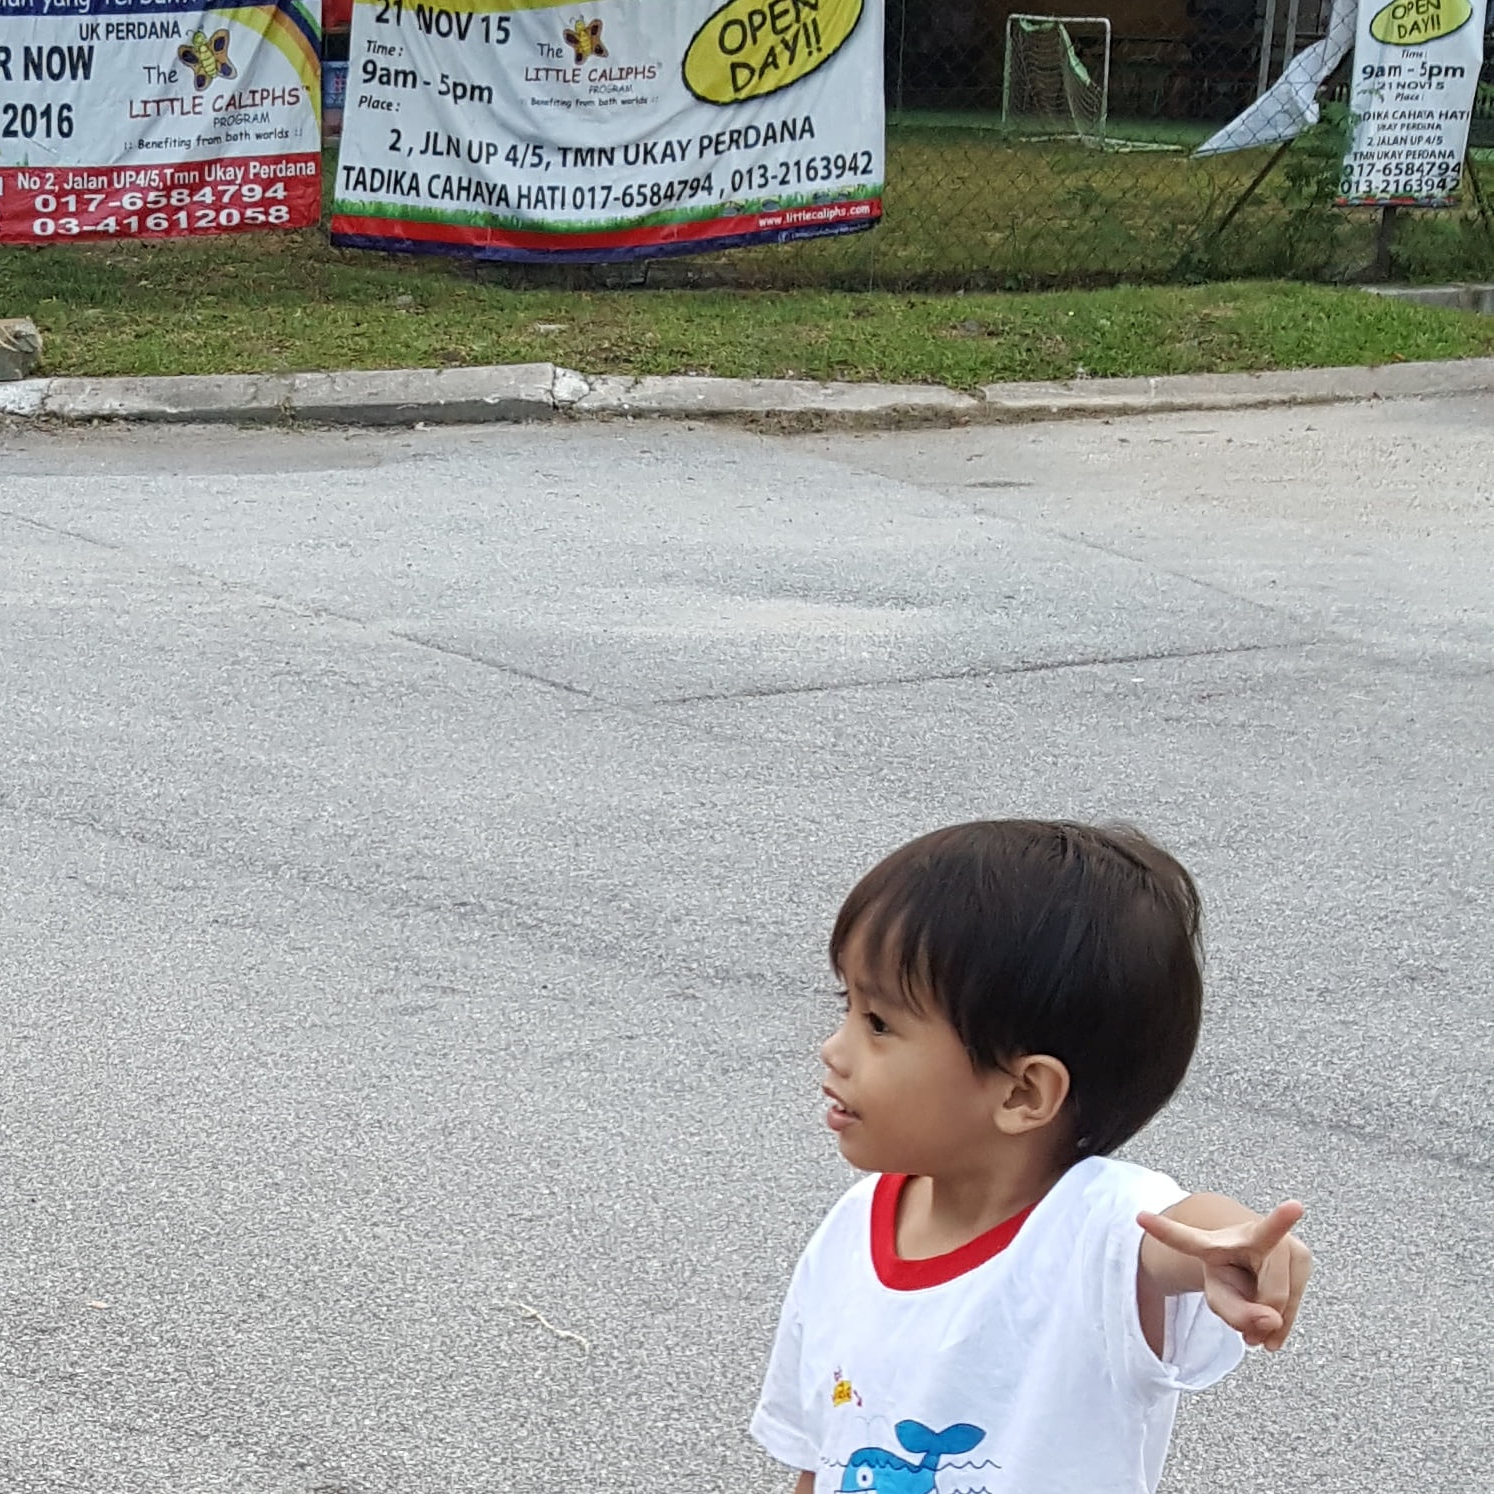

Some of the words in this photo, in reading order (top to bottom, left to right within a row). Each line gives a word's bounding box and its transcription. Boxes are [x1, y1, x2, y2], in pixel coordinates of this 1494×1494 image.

[1391, 0, 1442, 20] OPEN
[79, 23, 100, 41] UK
[105, 20, 182, 41] PERDANA
[375, 0, 402, 27] 21
[415, 2, 475, 42] NOV
[481, 15, 512, 45] 15
[717, 0, 820, 56] OPEN
[1397, 14, 1441, 39] DAY!!
[536, 42, 564, 59] The
[729, 17, 823, 94] DAY!!
[23, 45, 95, 82] NOW
[143, 65, 179, 85] The
[524, 67, 582, 84] LITTLE
[587, 66, 657, 83] CALIPHS
[1361, 64, 1402, 81] 9am
[1419, 61, 1465, 81] 5pm
[362, 59, 418, 90] 9am
[437, 74, 494, 105] 5pm
[128, 95, 204, 119] LITTLE
[1362, 111, 1388, 121] DIKA
[1438, 110, 1470, 120] HATI
[2, 102, 74, 139] 2016
[213, 111, 271, 128] PROGRAM
[137, 138, 192, 150] Benefiting
[196, 134, 222, 147] from
[225, 129, 251, 143] both
[255, 127, 290, 140] worlds
[419, 131, 461, 159] JLN
[467, 138, 499, 165] UP
[558, 145, 616, 168] TMN
[623, 138, 693, 167] UKAY
[698, 115, 815, 160] PERDANA
[1376, 136, 1408, 147] JALAN
[1377, 150, 1403, 160] UKAY
[1406, 149, 1455, 160] PERDANA
[17, 172, 40, 190] No
[44, 172, 59, 193] 2,
[63, 171, 108, 190] Jalan
[205, 162, 245, 184] Ukay
[249, 159, 316, 180] Perdana
[342, 165, 421, 198] TADIKA
[426, 173, 509, 210] CAHAYA
[516, 184, 567, 211] HATI
[572, 172, 714, 210] 017-6584794
[730, 150, 874, 193] 013-2163942
[1343, 162, 1462, 178] 017-6584794
[34, 181, 289, 213] 017-6584794
[1340, 177, 1460, 195] 013-2163942
[32, 204, 291, 236] 03-41612058
